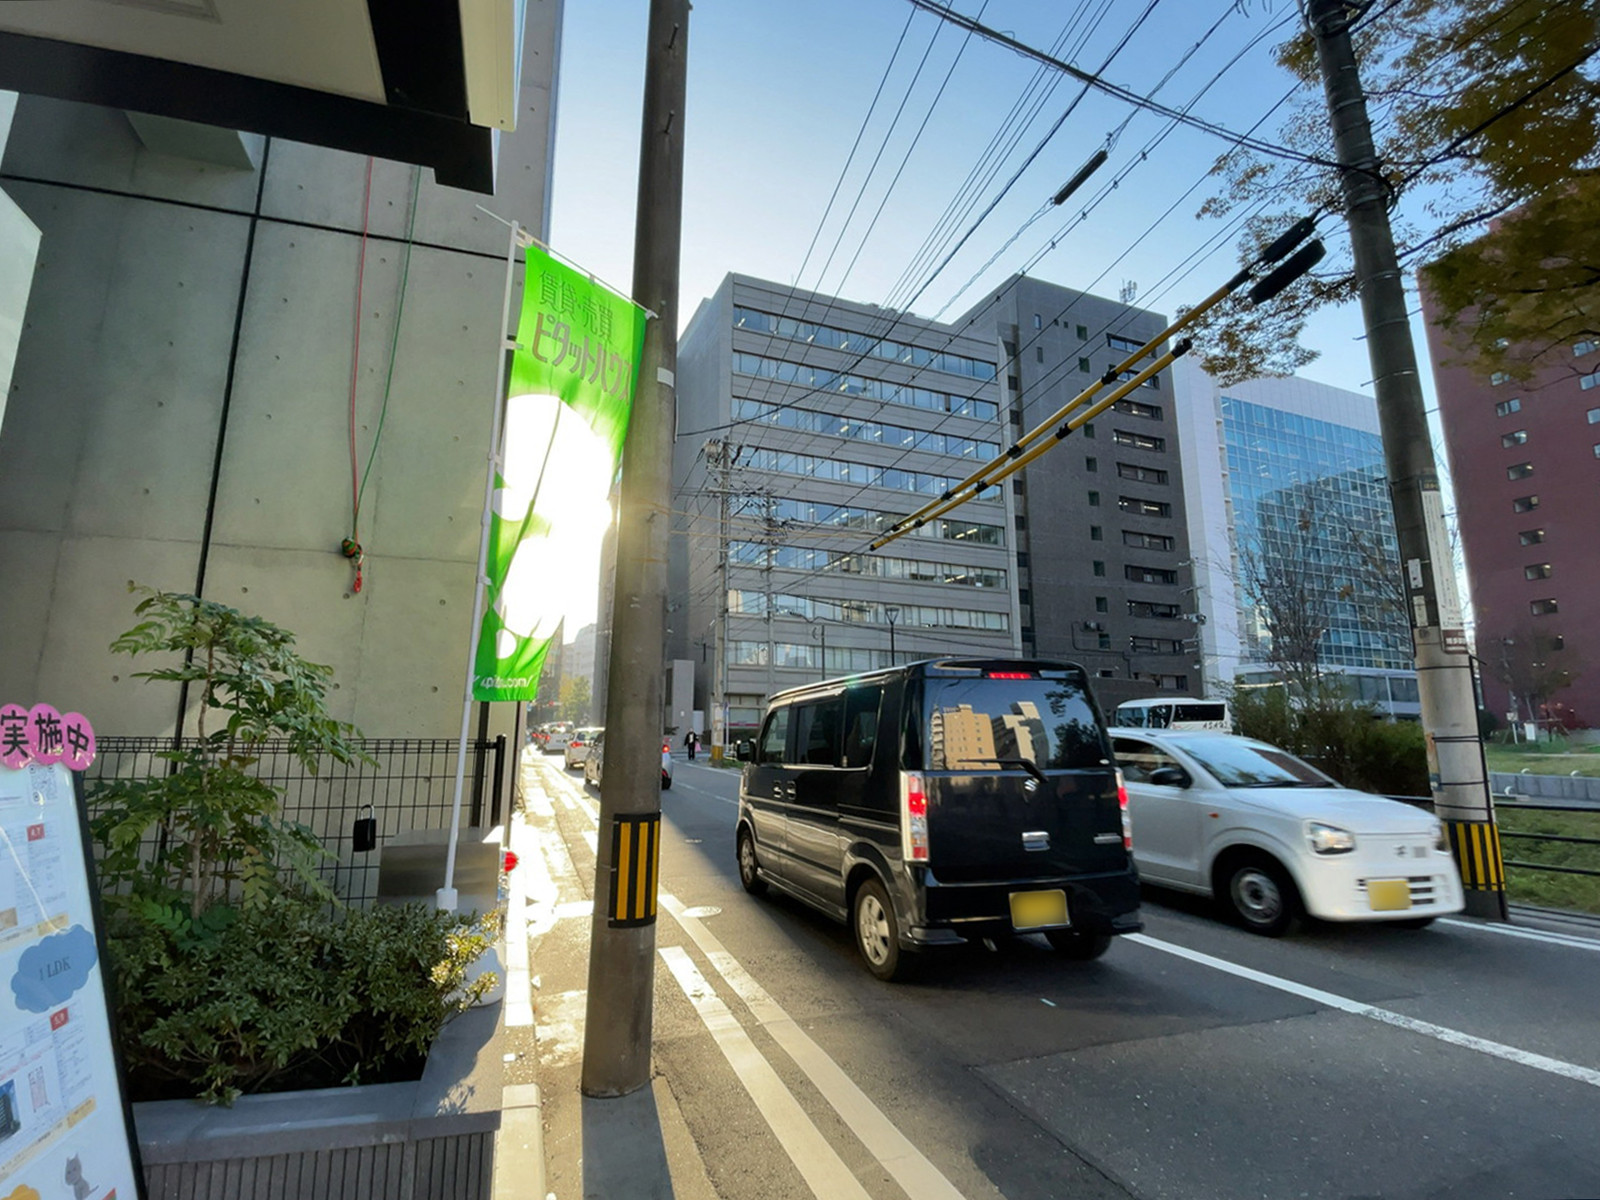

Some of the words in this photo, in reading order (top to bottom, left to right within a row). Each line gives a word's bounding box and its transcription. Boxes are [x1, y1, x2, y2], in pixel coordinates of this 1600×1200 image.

[532, 312, 633, 405] ピタットハウス
[0, 709, 90, 760] 実施中
